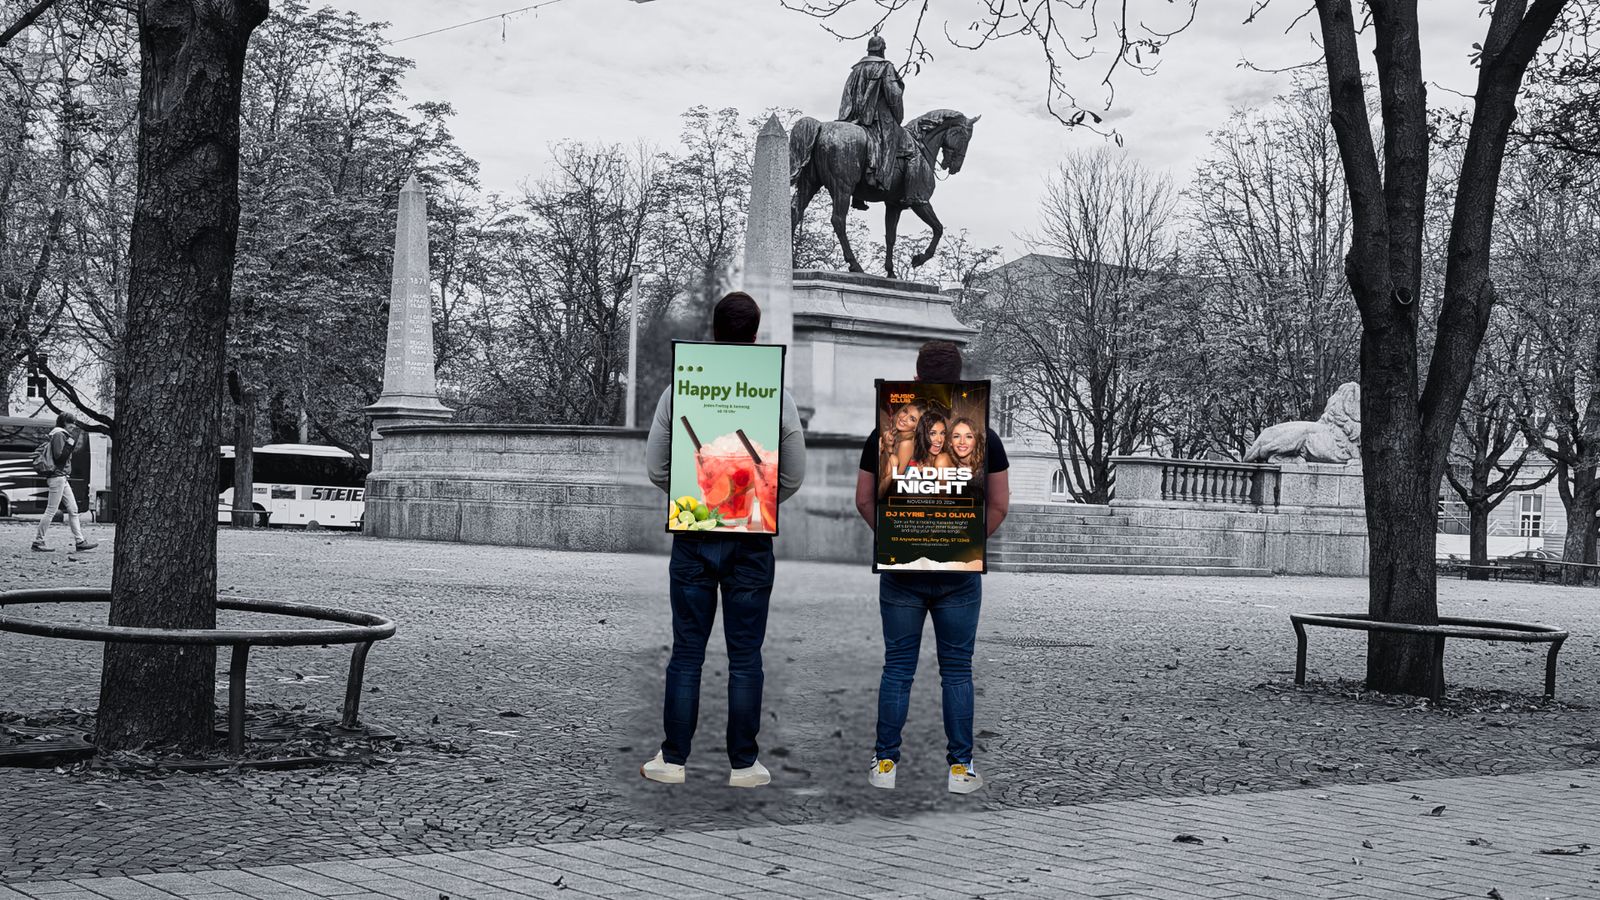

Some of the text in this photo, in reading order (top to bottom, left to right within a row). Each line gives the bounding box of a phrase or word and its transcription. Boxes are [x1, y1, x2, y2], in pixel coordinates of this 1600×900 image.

[678, 379, 777, 401] Happy Hour
[892, 466, 972, 480] LADIES
[311, 487, 365, 501] STEIE
[897, 480, 967, 494] NIGHT
